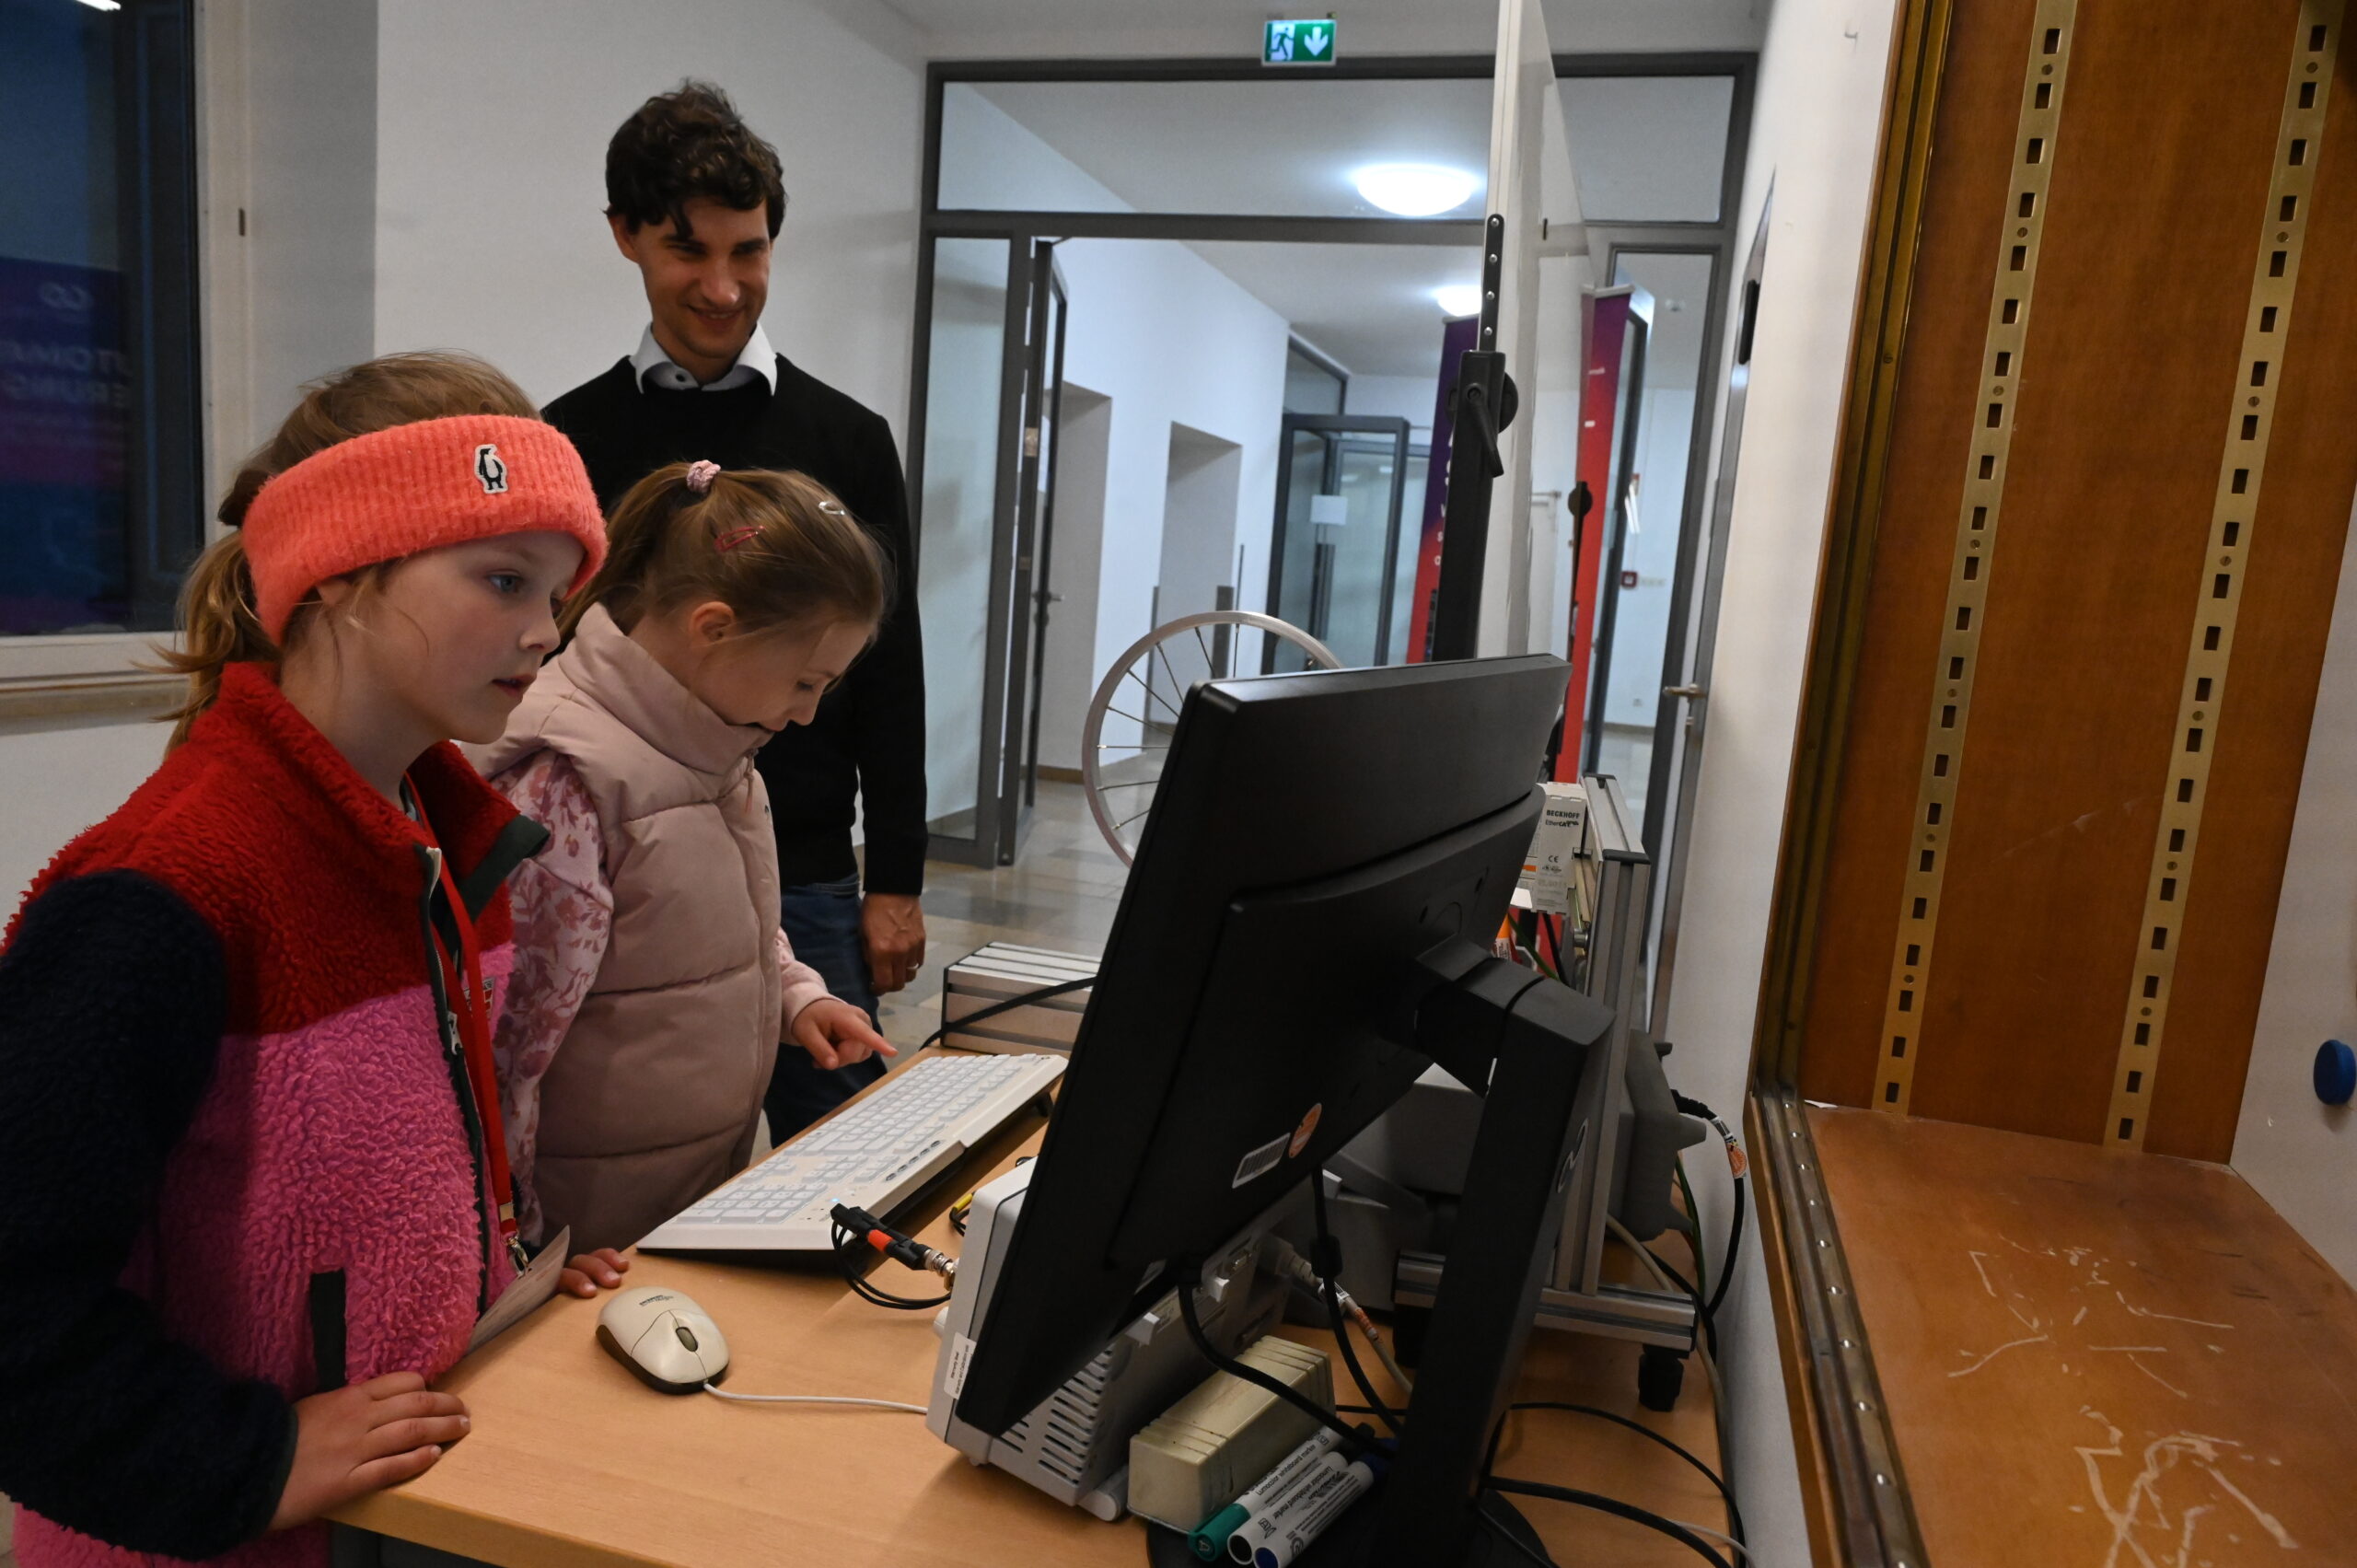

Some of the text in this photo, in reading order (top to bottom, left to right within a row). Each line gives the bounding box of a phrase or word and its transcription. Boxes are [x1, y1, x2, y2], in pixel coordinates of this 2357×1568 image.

[1547, 810, 1580, 819] BECKHOFF
[1256, 1475, 1280, 1496] Lumocolor
[1310, 1466, 1334, 1486] Lumocolor
[1287, 1483, 1313, 1507] whiteboard
[1272, 1503, 1289, 1520] marker
